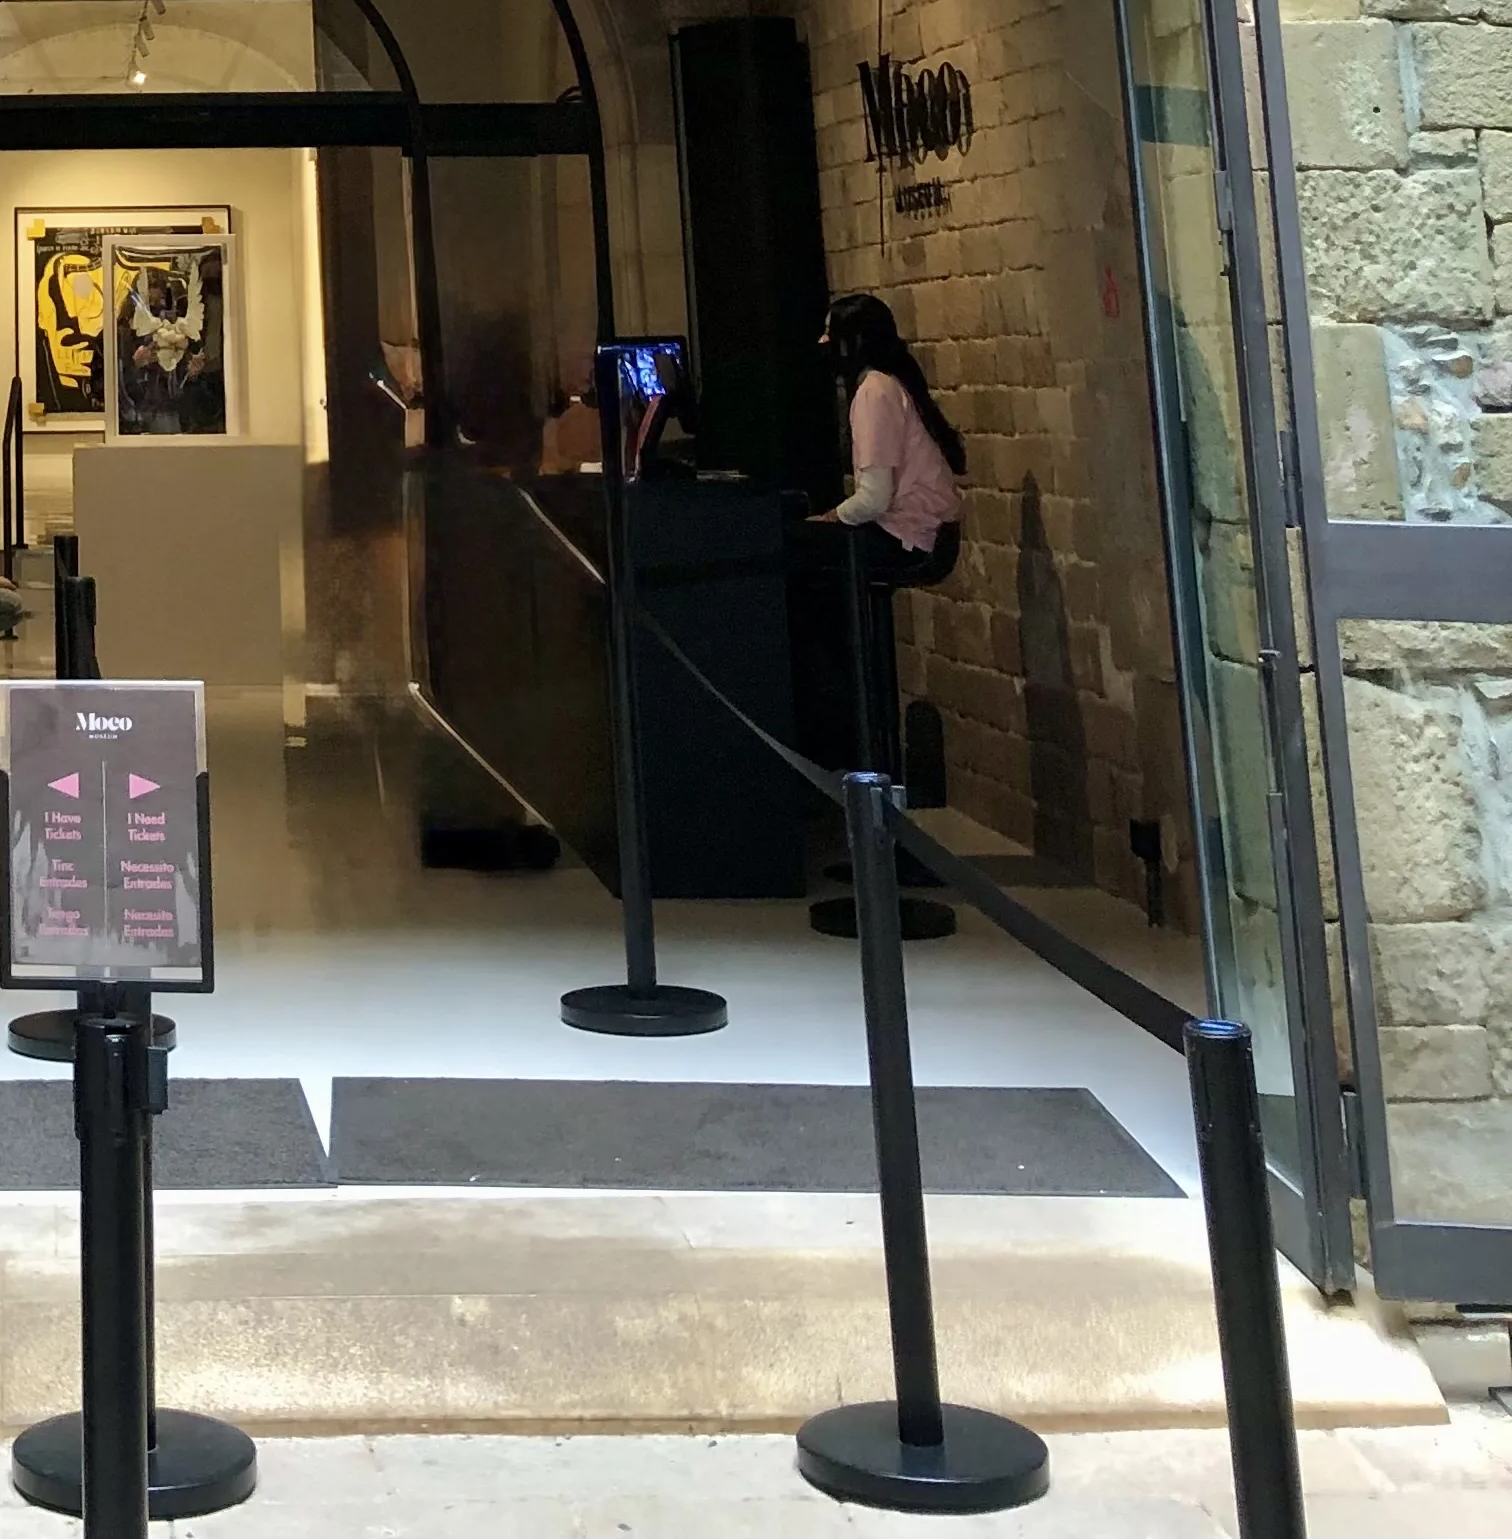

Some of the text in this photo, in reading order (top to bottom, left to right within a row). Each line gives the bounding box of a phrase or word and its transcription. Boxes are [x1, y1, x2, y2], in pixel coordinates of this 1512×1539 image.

[75, 712, 133, 732] Moco
[52, 811, 82, 824] Have
[134, 812, 166, 825] Need
[44, 827, 82, 840] Tickets
[127, 828, 166, 842] Tickets
